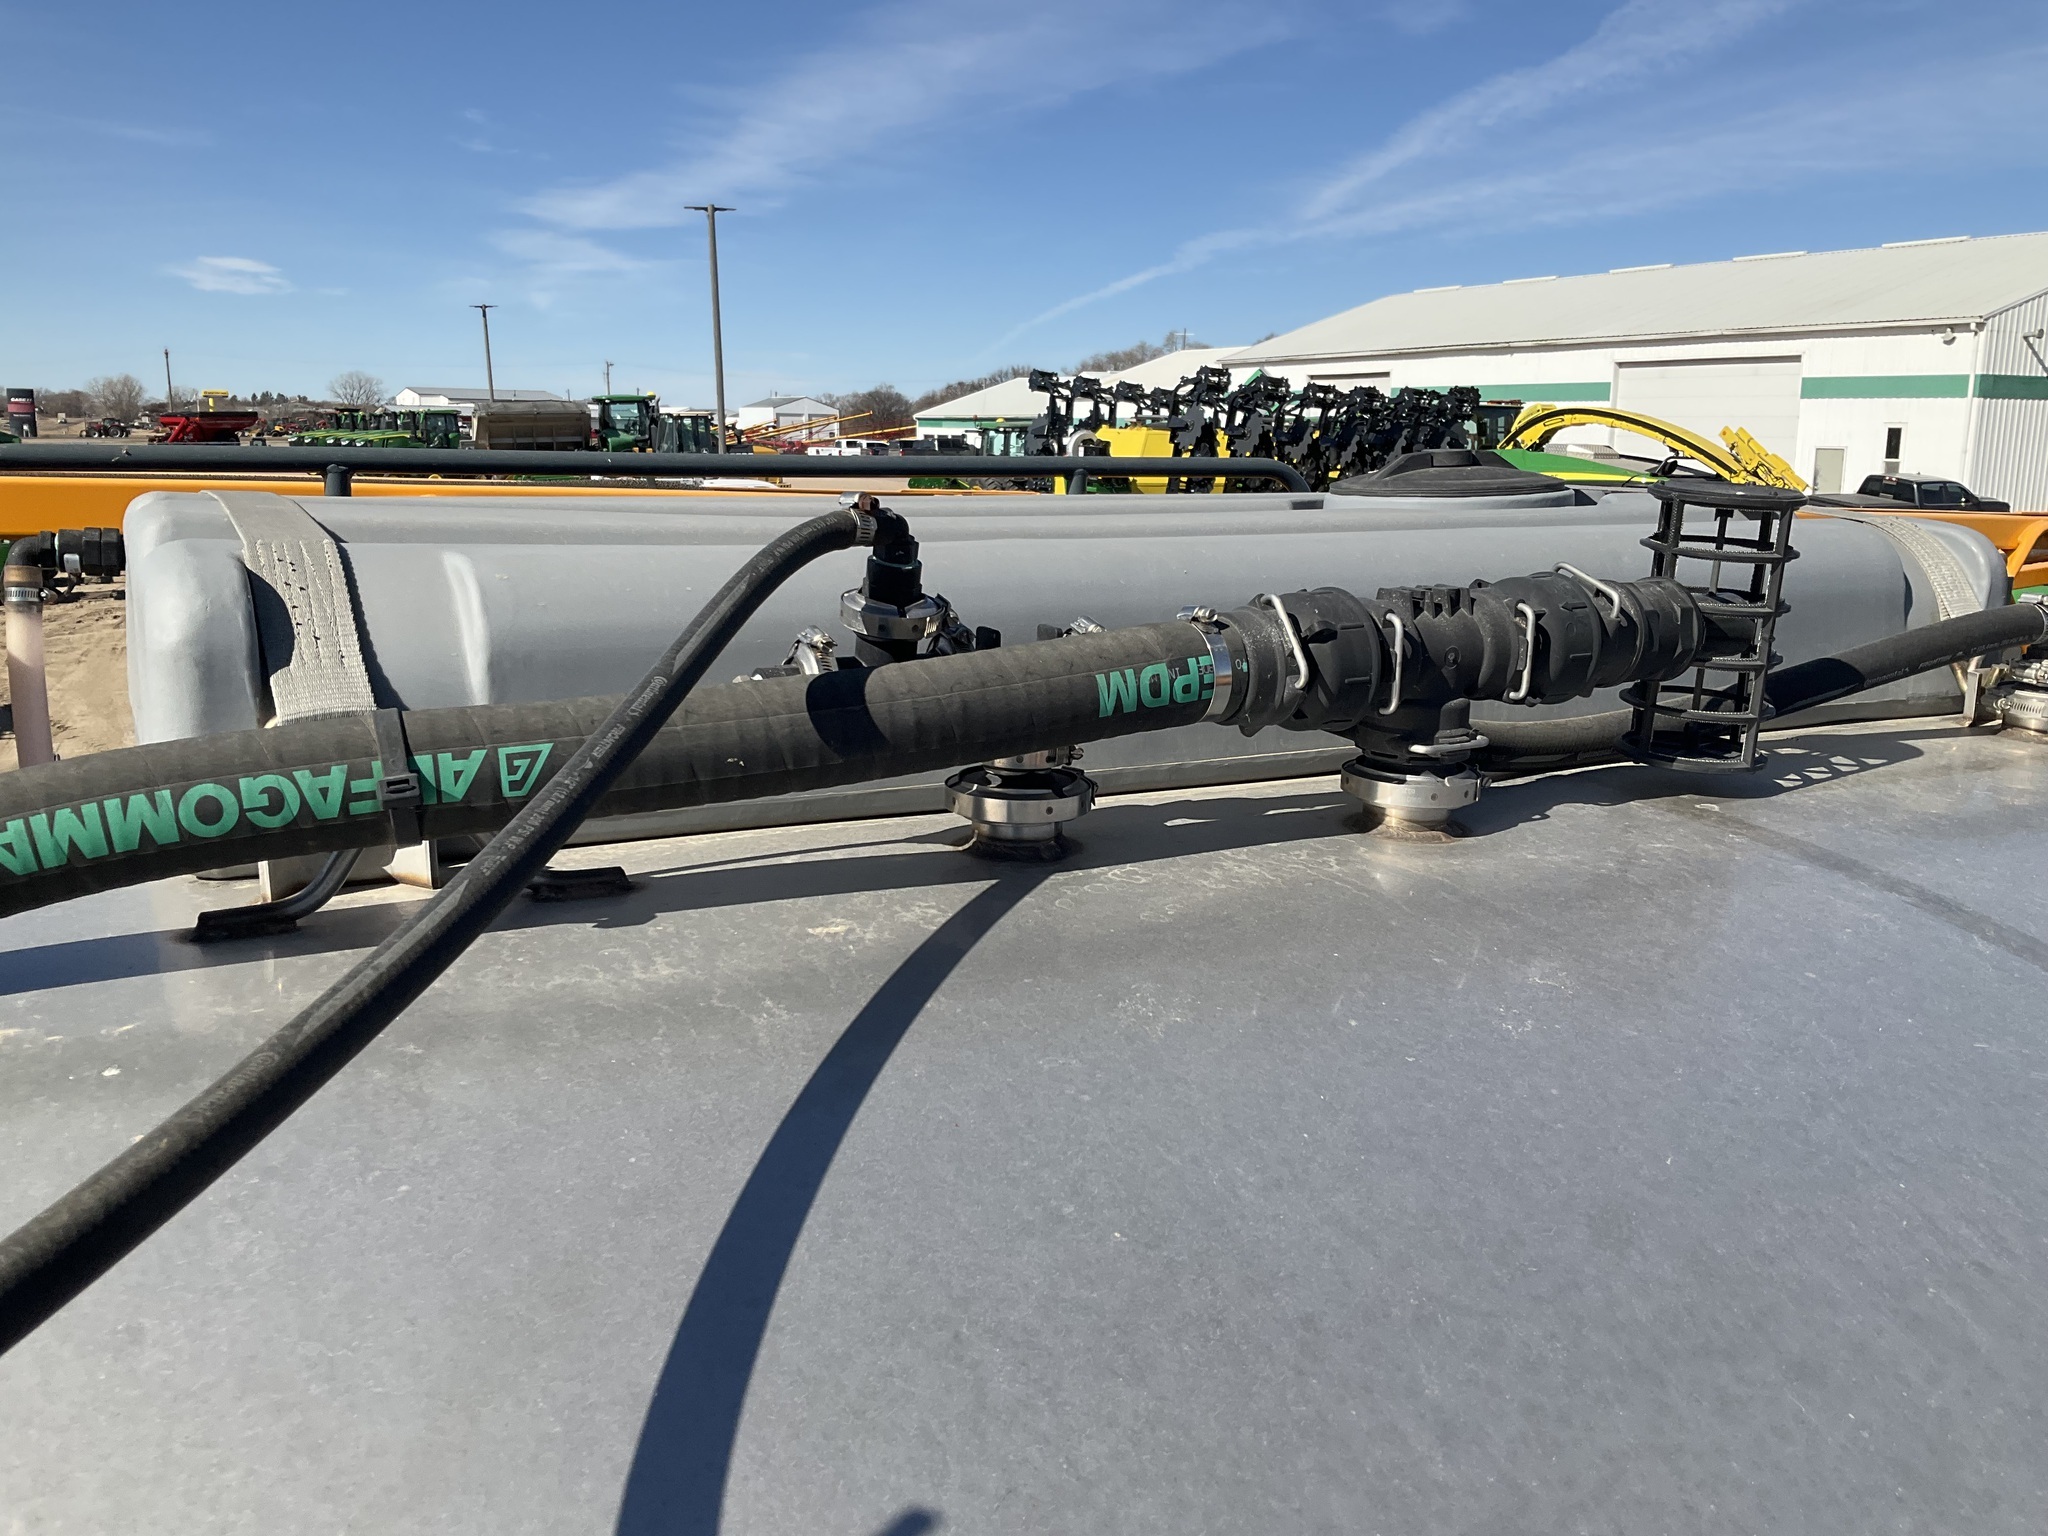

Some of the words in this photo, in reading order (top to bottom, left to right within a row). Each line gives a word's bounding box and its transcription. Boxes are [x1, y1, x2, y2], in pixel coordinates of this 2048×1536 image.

[1096, 655, 1214, 717] EPDM
[591, 723, 626, 759] FRONTIER
[0, 749, 487, 876] ALFAGOMMA
